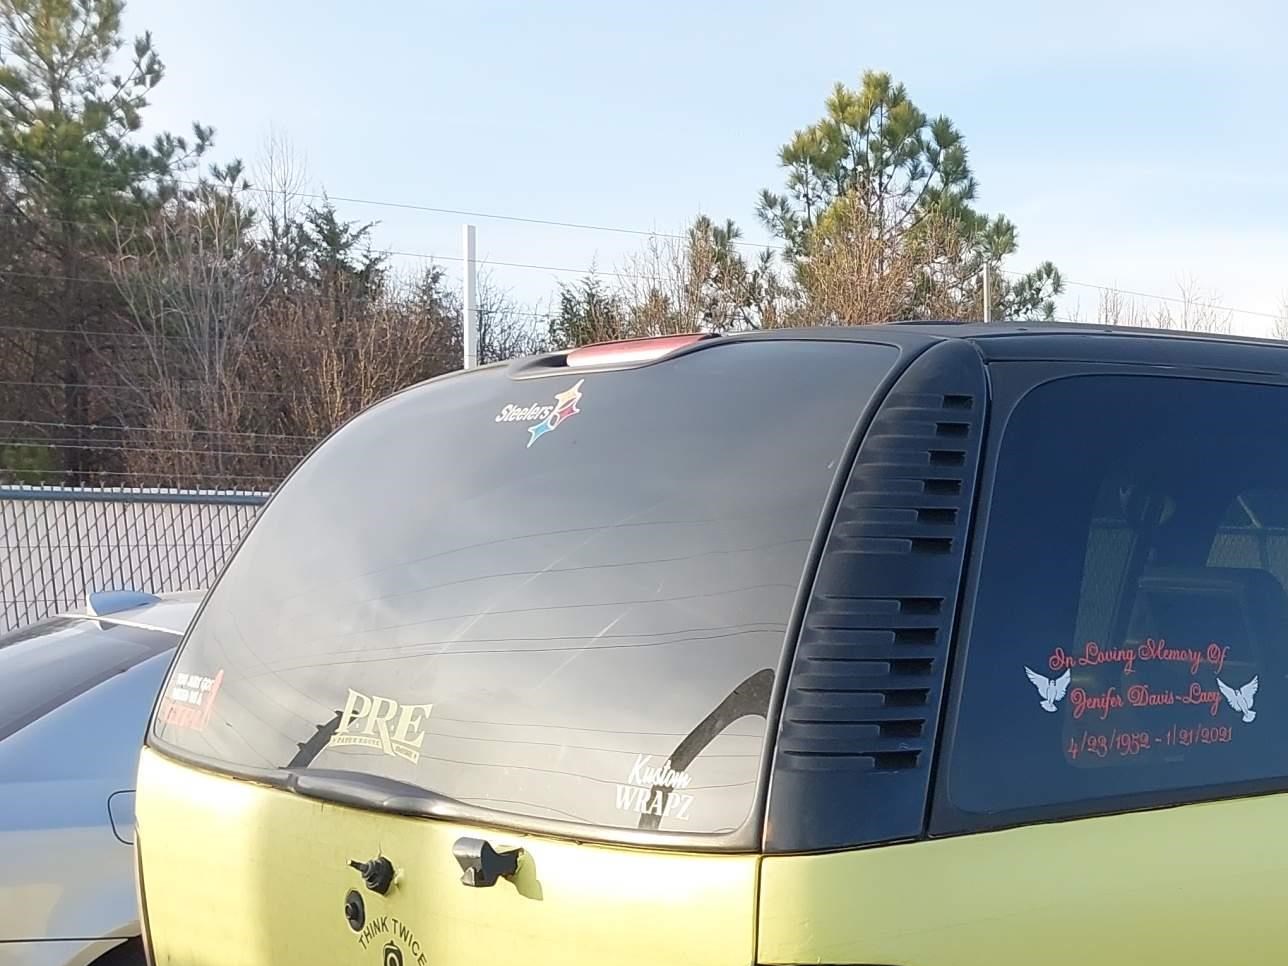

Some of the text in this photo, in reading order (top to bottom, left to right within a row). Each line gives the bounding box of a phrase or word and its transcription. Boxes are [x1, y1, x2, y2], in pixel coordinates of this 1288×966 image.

[495, 402, 554, 422] Steelers
[1049, 638, 1230, 675] In Loving Memory Of
[1070, 687, 1124, 719] Jenifer
[334, 688, 433, 756] PRE
[1067, 729, 1151, 760] 4/23/1952
[628, 753, 692, 788] Kustom
[615, 783, 695, 821] WRAPZ
[359, 916, 389, 950] THINK
